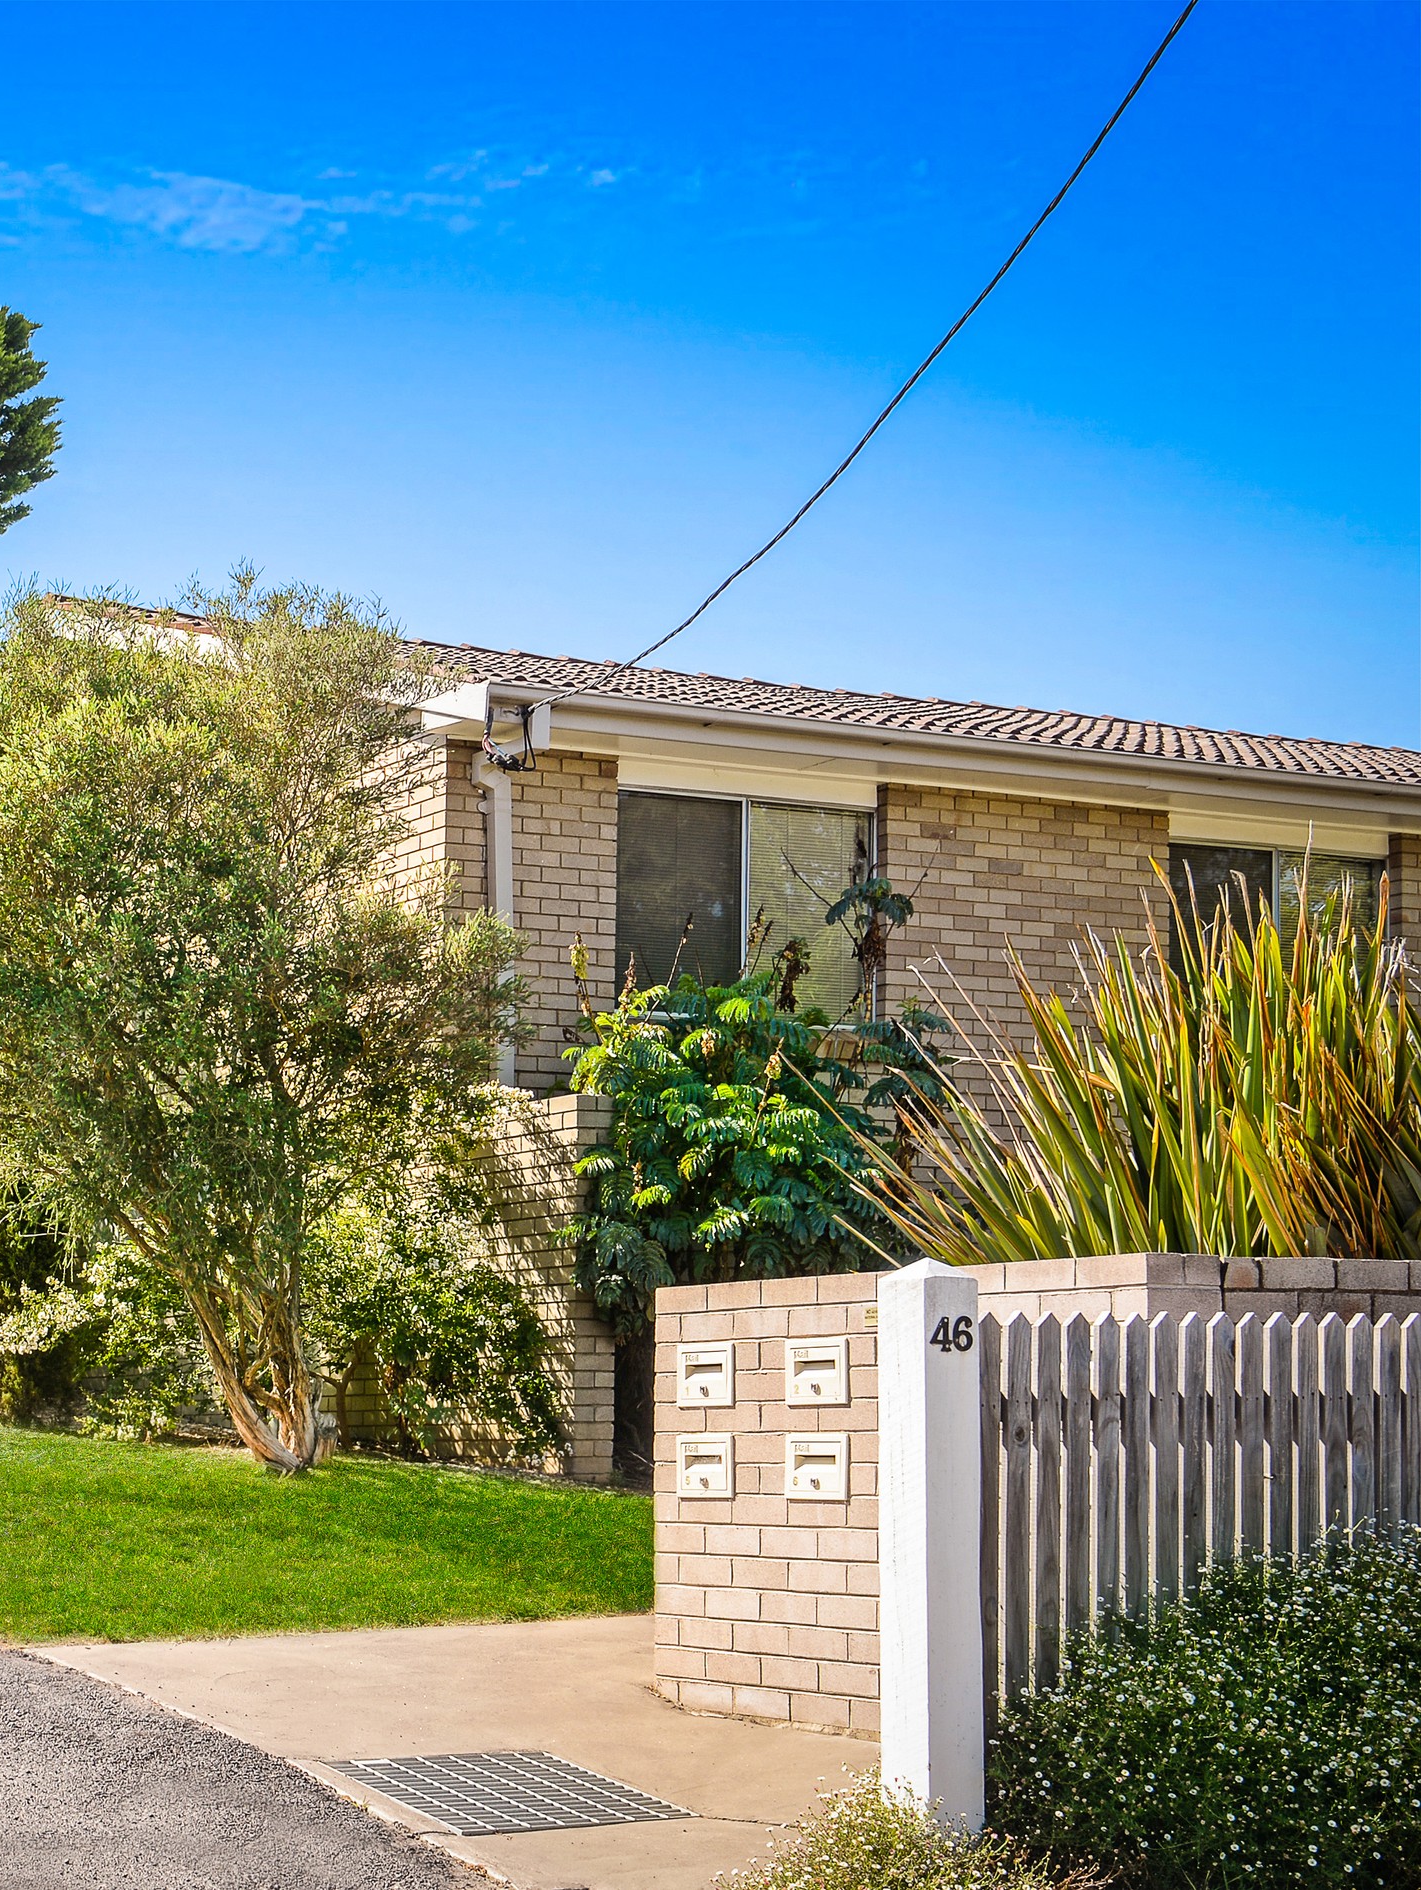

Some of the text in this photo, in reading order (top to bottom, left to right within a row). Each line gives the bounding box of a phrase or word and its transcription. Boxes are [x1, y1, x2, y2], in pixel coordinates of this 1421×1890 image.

[929, 1315, 974, 1353] 46
[793, 1383, 800, 1395] 2
[684, 1475, 691, 1486] 5
[792, 1476, 799, 1487] 6
